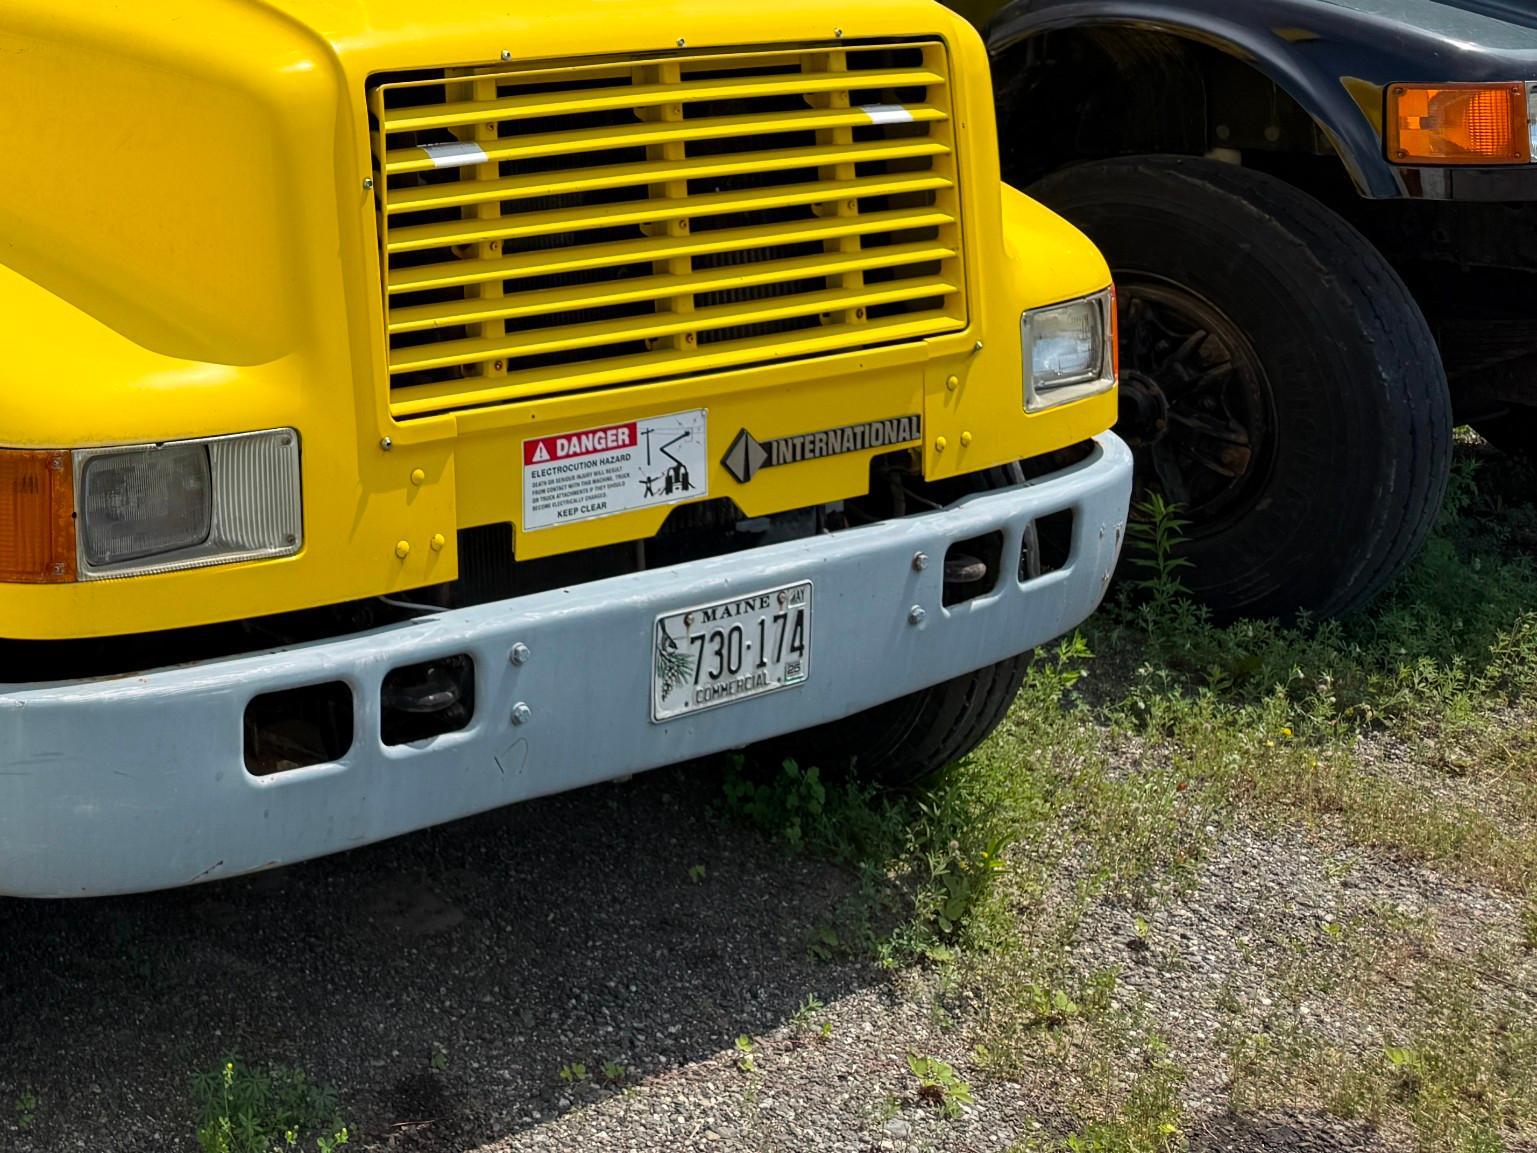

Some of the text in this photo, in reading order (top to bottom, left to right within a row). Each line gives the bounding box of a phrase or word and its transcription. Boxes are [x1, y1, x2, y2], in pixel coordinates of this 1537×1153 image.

[556, 427, 630, 457] DANGER
[771, 415, 921, 466] INTERNATIONAL
[531, 452, 631, 479] ELECTROCUTION HAZARD
[556, 501, 608, 519] KEEP CLEAR
[701, 595, 771, 624] MAINE
[694, 670, 770, 704] COMMERCIAL
